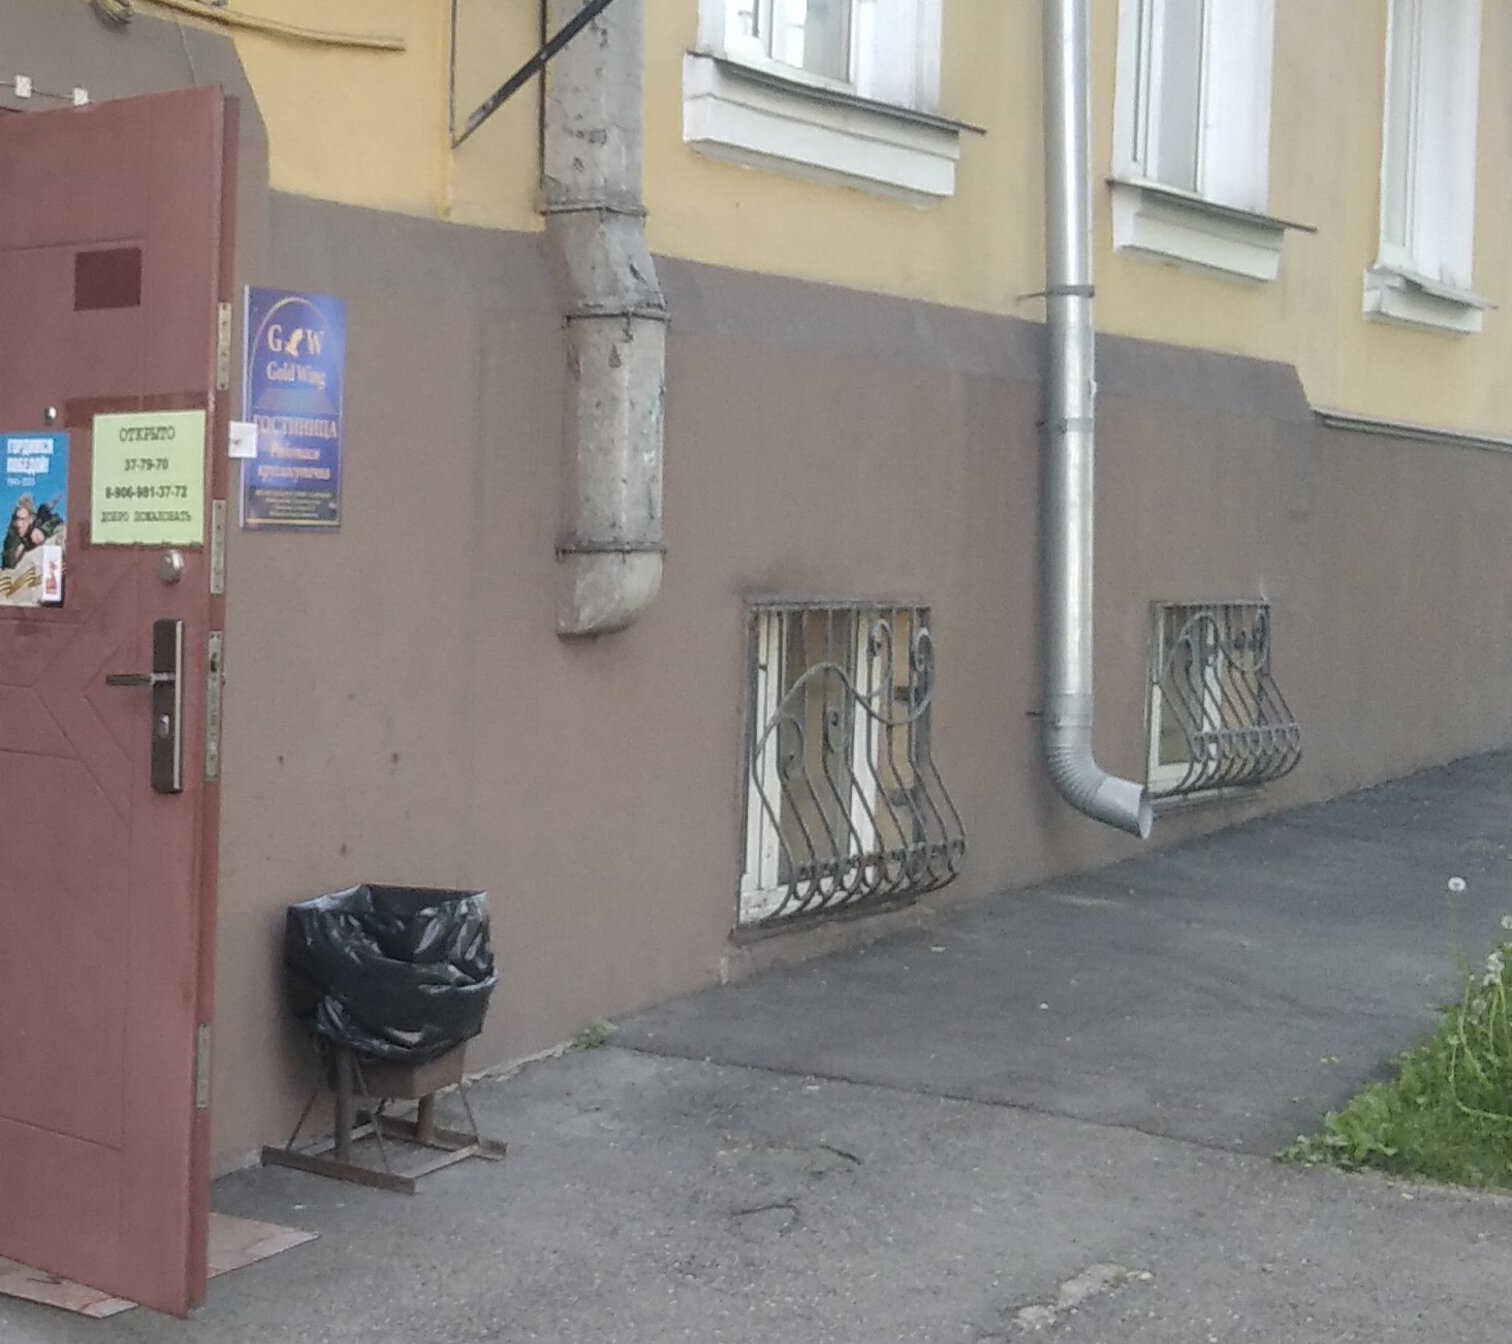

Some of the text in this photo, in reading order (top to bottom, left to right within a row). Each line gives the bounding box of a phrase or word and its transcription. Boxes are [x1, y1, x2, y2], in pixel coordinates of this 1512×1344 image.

[266, 360, 326, 391] Gold Wing
[119, 425, 176, 442] ОТКРЫТО
[253, 415, 337, 440] ГОСТИНИЦА
[125, 458, 169, 471] 37-79-70
[100, 510, 192, 524] ДОБРО ПОЖАЛОВАТЬ
